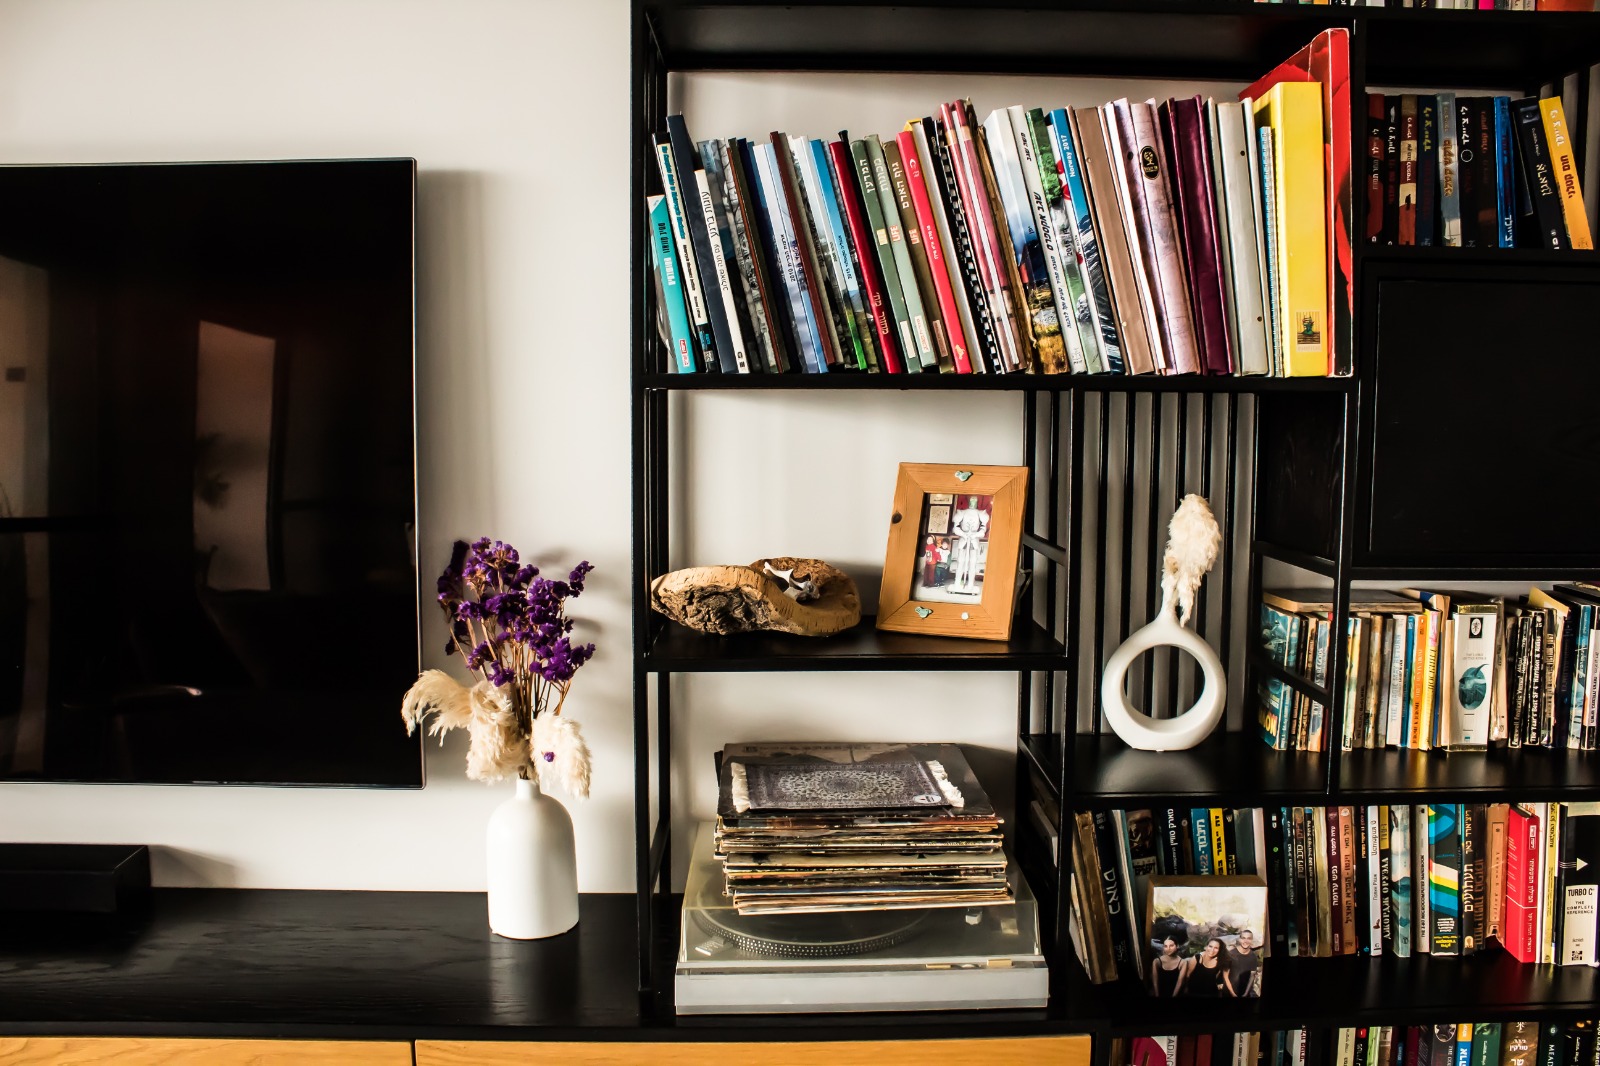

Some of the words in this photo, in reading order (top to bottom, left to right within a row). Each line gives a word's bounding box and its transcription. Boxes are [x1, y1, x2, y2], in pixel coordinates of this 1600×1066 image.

[1423, 106, 1432, 117] לי
[1461, 106, 1468, 116] לי
[1550, 109, 1558, 118] לי
[1020, 132, 1028, 147] משה
[1024, 148, 1032, 162] שגב
[1061, 134, 1070, 150] 2017
[1443, 140, 1453, 165] מוקש
[859, 159, 876, 194] המדען
[873, 158, 889, 192] מכונות
[890, 161, 904, 177] גוף
[1065, 152, 1076, 178] Norway
[896, 181, 910, 209] האדם
[1564, 174, 1575, 198] קטלני
[1033, 192, 1044, 212] שגב
[701, 192, 712, 213] עוגות
[707, 216, 719, 238] ברגע
[890, 225, 901, 241] LIFE
[909, 228, 920, 244] LIFE
[1037, 215, 1054, 251] אקספרס
[1167, 809, 1176, 828] מארק
[1103, 867, 1121, 914] כאוס
[1463, 864, 1474, 912] תעתועים
[1382, 896, 1392, 940] ДЖОРДЖ
